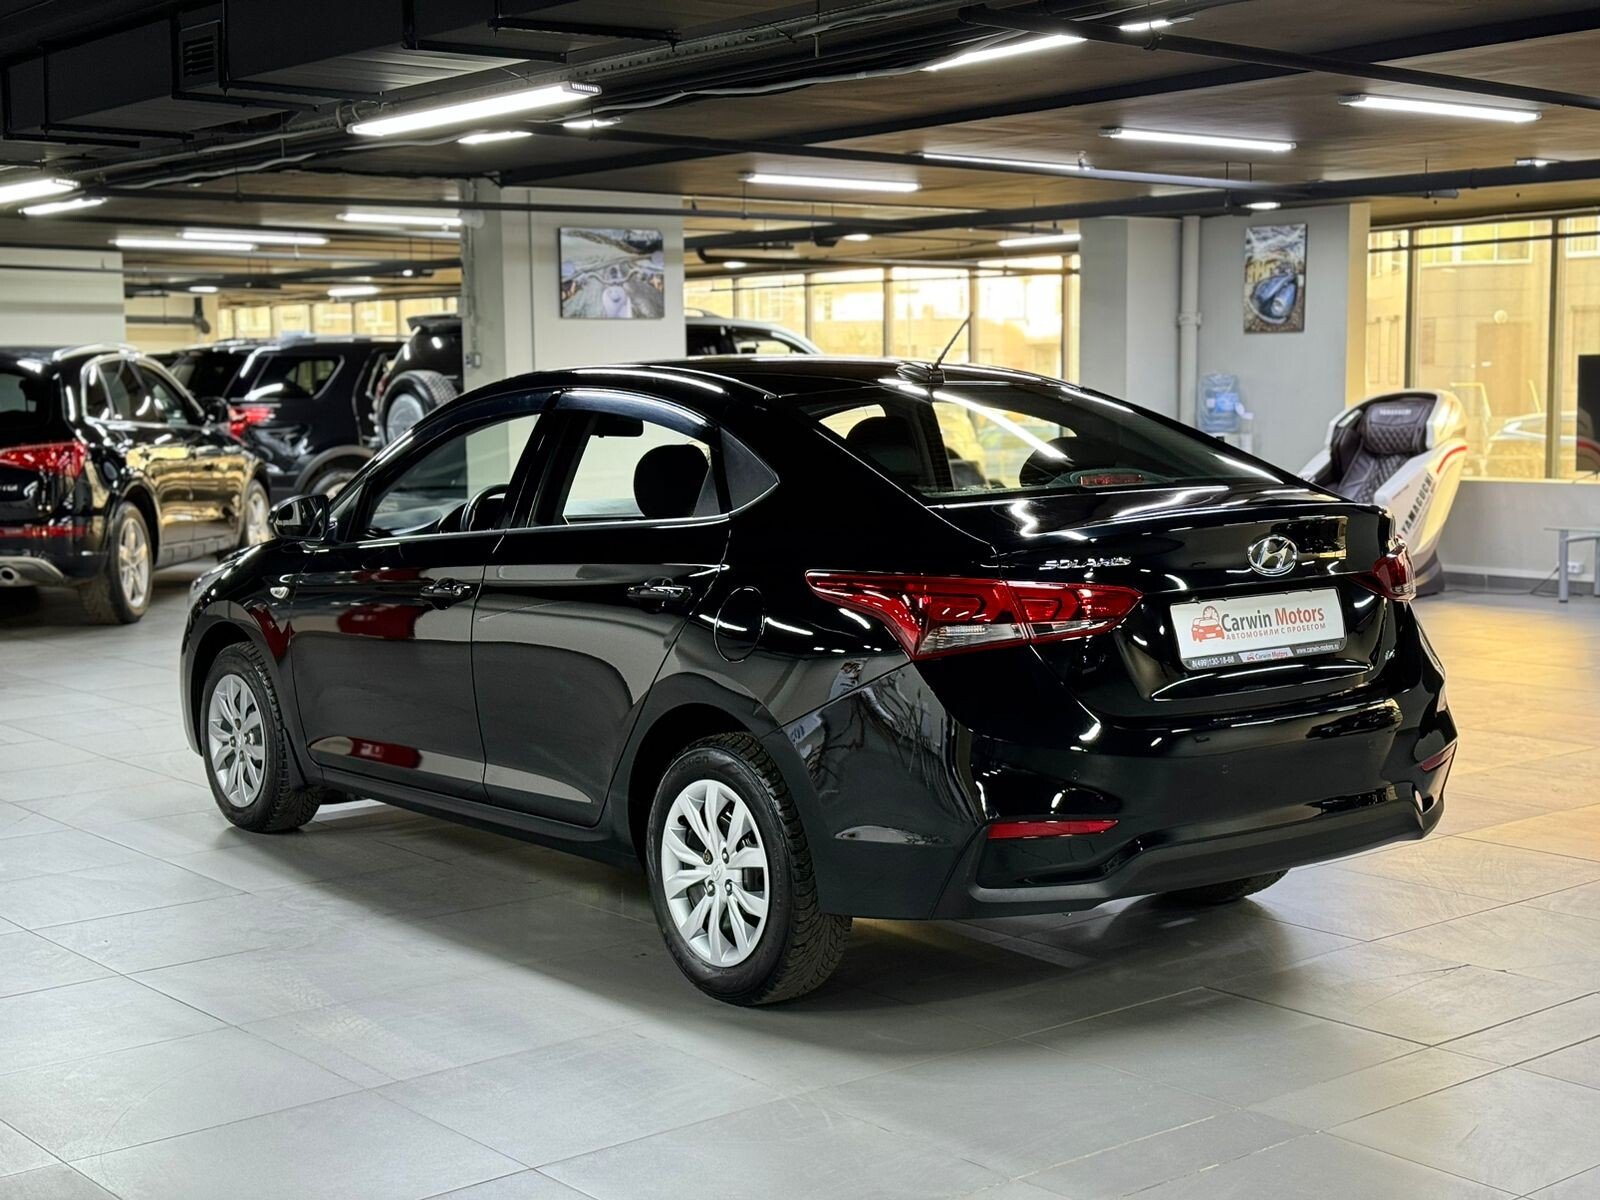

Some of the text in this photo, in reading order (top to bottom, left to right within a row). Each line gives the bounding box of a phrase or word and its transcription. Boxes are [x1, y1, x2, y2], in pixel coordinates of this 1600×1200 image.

[1401, 472, 1433, 535] YAMAGUCHI
[1221, 607, 1325, 633] Carwin Motors
[1226, 628, 1280, 641] АВТОМОБИЛИ
[1287, 623, 1326, 633] ПРОБЕГОМ
